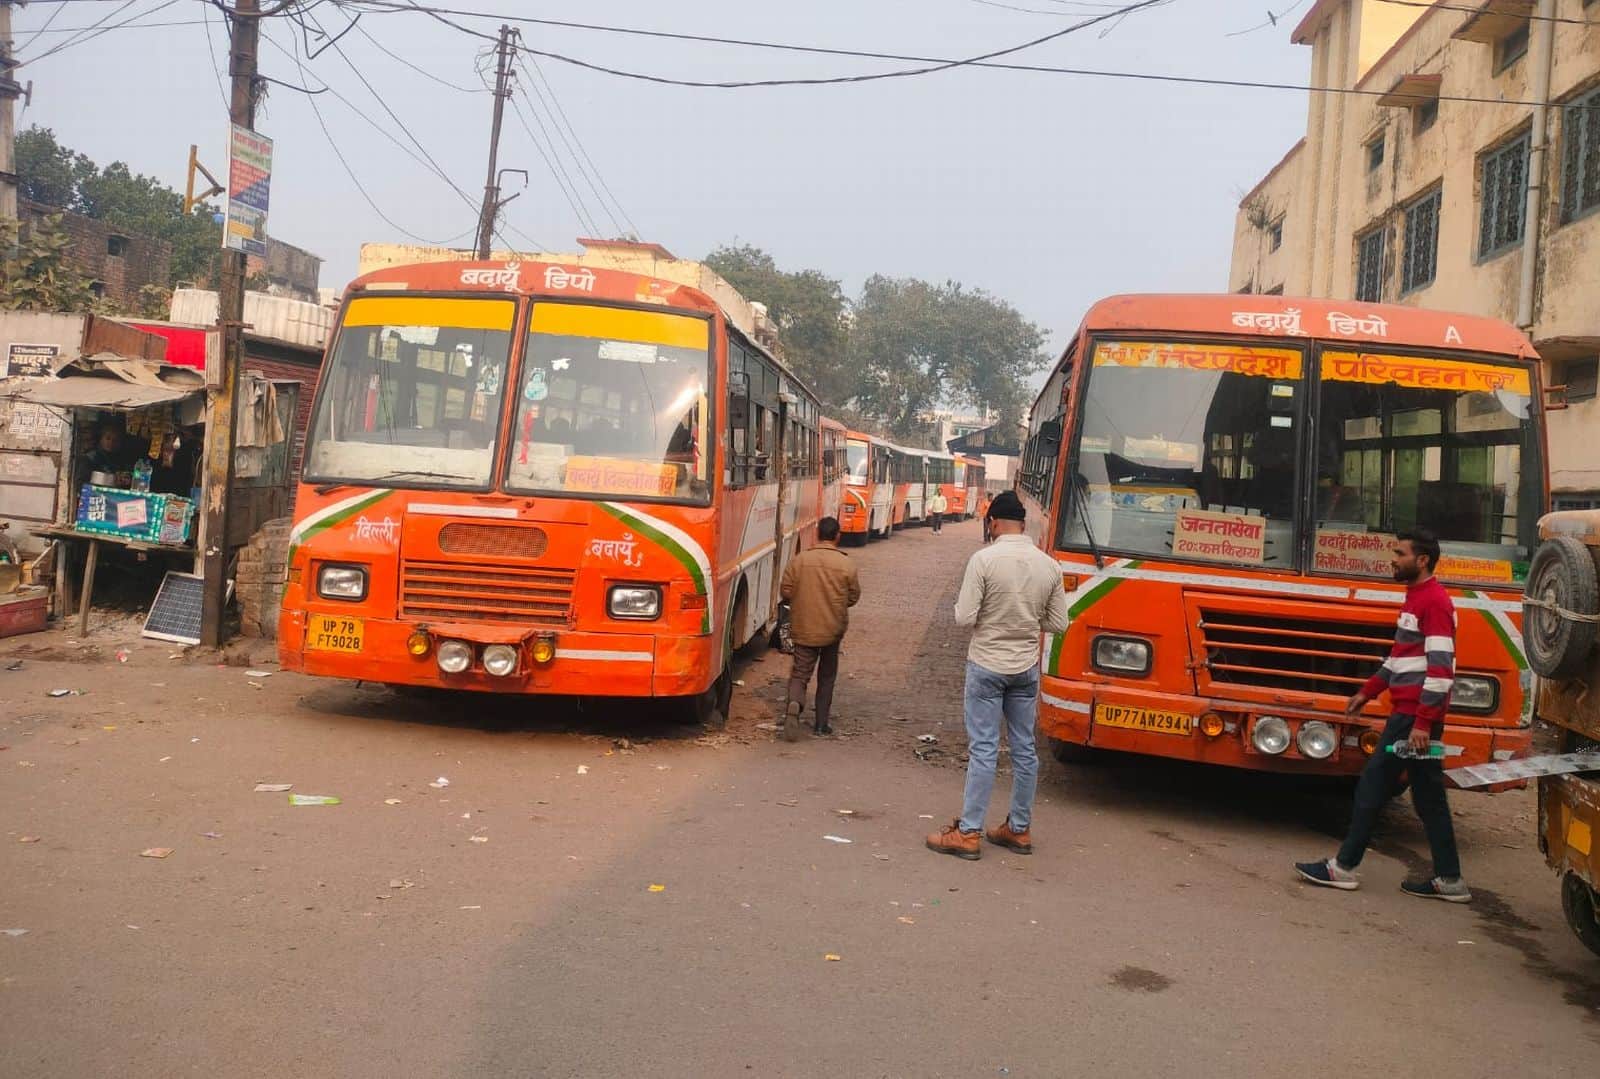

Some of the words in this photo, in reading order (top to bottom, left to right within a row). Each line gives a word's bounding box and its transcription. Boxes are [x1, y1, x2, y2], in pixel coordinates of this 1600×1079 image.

[460, 262, 523, 293] बदायूँ
[543, 266, 596, 292] डिपो
[1231, 307, 1308, 337] बदायूँ
[1326, 311, 1389, 337] डिपो
[1444, 325, 1462, 344] A
[1332, 356, 1468, 387] परिवहन
[354, 516, 400, 541] दिल्ली
[591, 532, 643, 567] बदायूँ
[323, 619, 336, 633] UP
[341, 622, 354, 634] 78
[317, 632, 360, 650] FT9028
